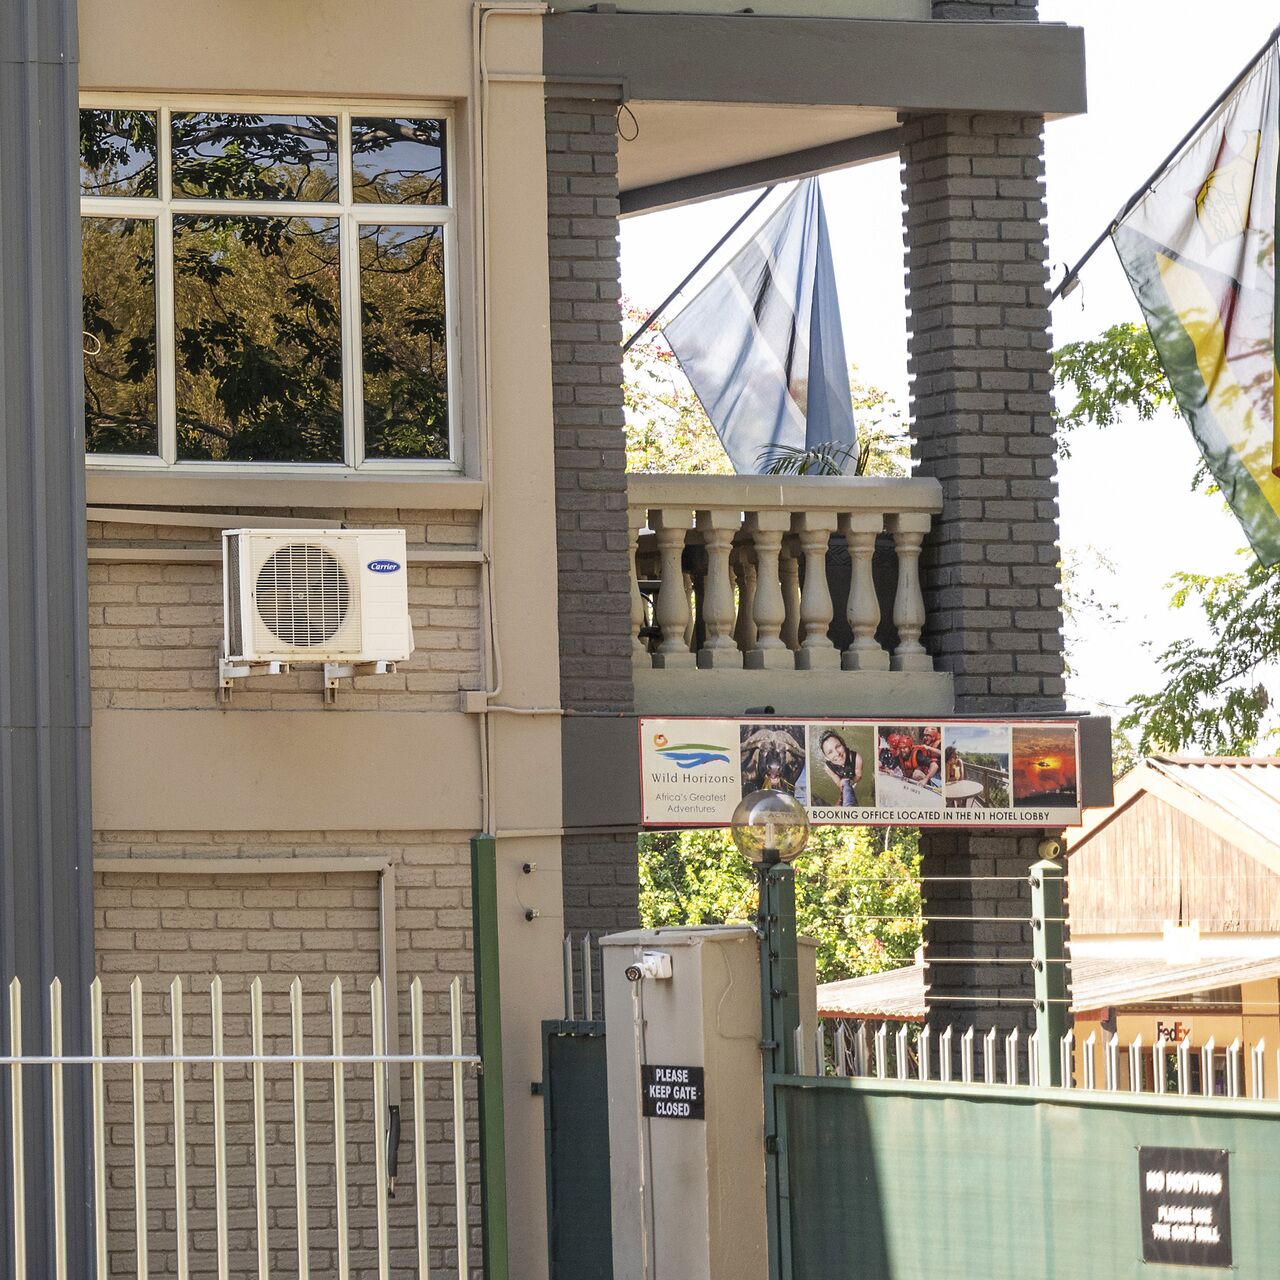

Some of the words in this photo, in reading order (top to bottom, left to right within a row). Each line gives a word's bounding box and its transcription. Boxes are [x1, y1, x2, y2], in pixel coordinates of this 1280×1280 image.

[370, 562, 397, 572] Carrier
[652, 773, 678, 784] Wild
[683, 773, 735, 784] Horizons
[655, 793, 688, 803] Africa's
[690, 793, 726, 803] Greatest
[667, 805, 716, 814] Adventures
[813, 810, 858, 820] BOOKING
[861, 810, 894, 820] OFFICE
[897, 811, 940, 820] LOCATED
[943, 811, 953, 820] IN
[956, 811, 971, 820] THE
[974, 811, 986, 820] N1
[989, 811, 1017, 821] HOTEL
[1020, 811, 1049, 821] LOBBY
[1157, 1021, 1190, 1042] FedEx
[656, 1068, 688, 1082] PLEASE
[649, 1085, 671, 1098] KEEP
[673, 1086, 697, 1099] GATE
[656, 1102, 690, 1116] CLOSED
